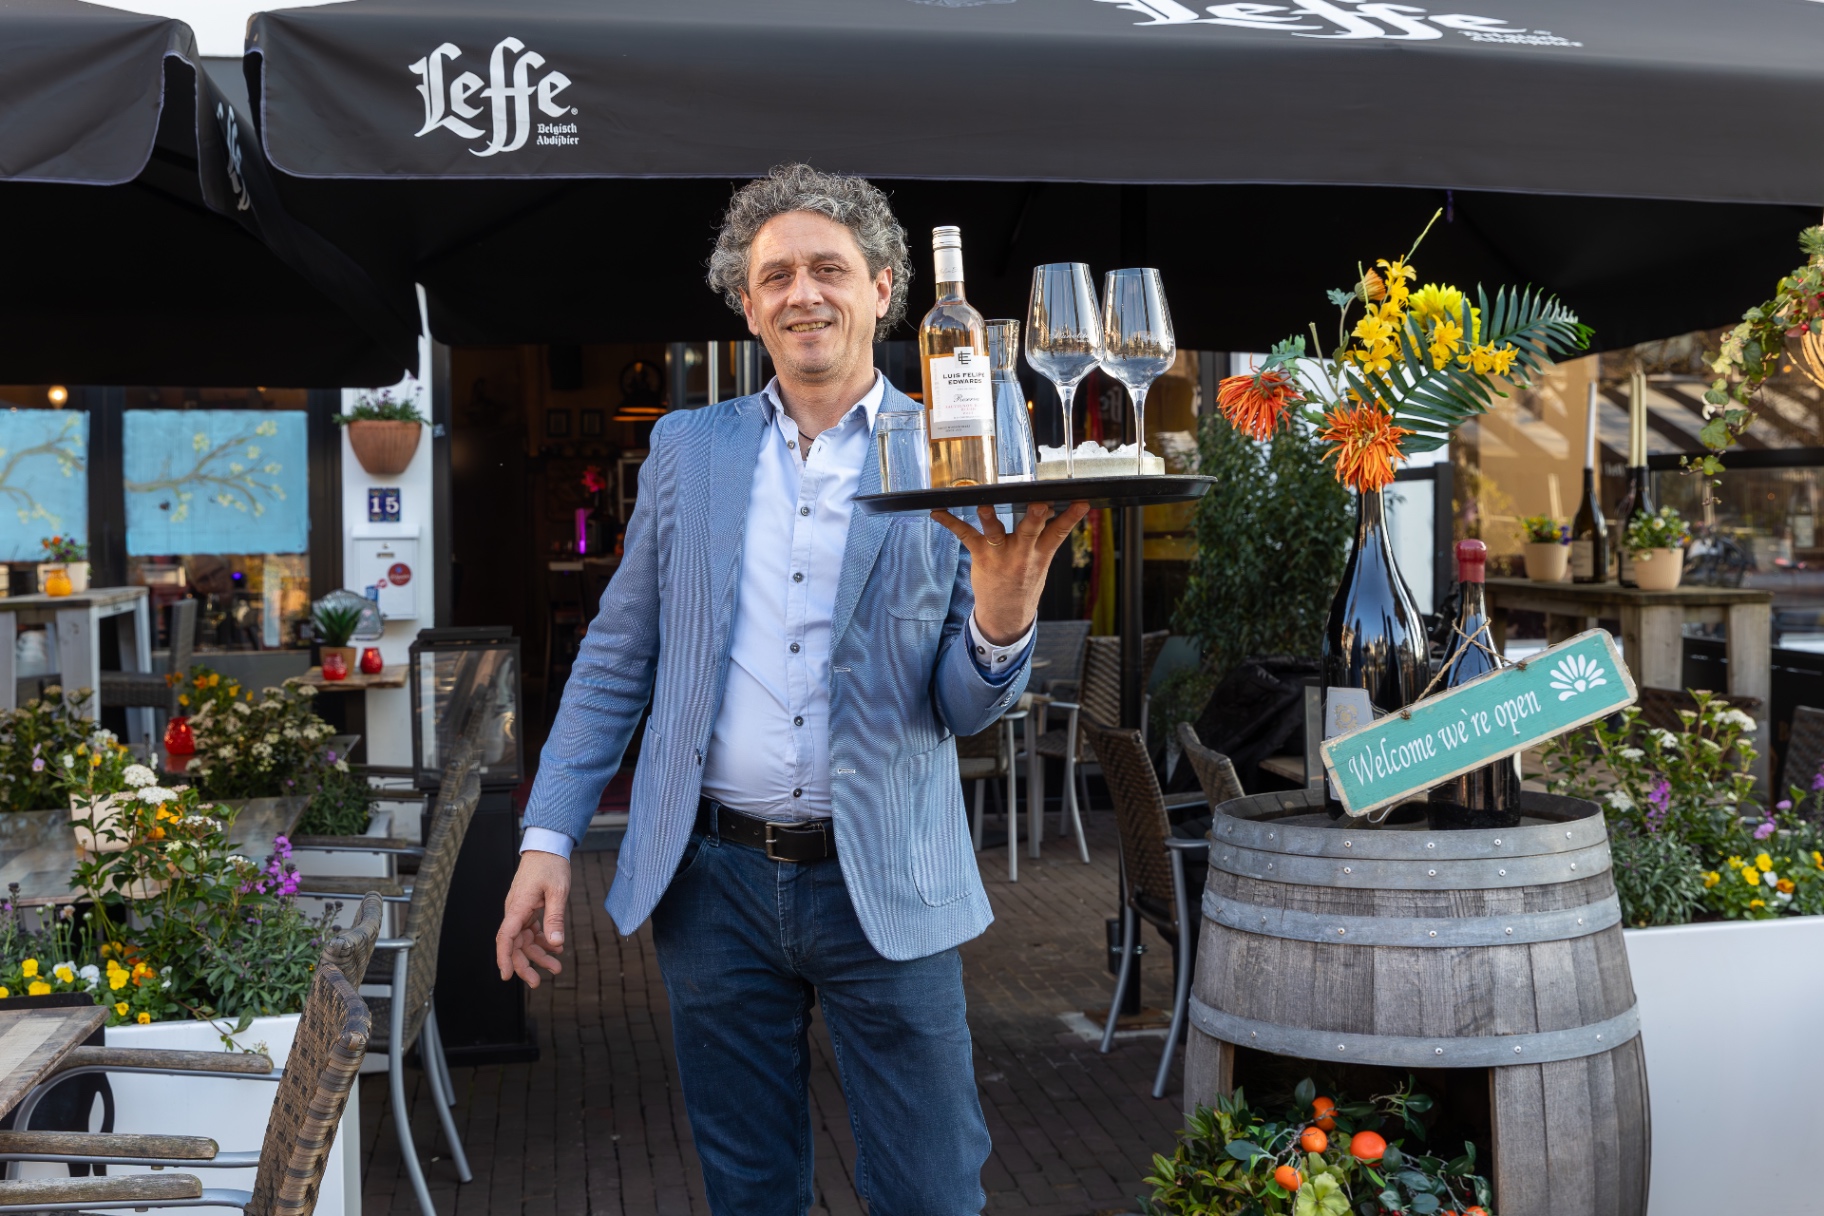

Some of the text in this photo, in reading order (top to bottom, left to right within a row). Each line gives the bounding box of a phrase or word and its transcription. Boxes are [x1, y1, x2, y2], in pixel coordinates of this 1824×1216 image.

[1096, 0, 1527, 40] Leffe
[408, 36, 572, 157] Leffe
[536, 123, 578, 135] Belgisch
[536, 135, 580, 147] Abdijbier
[370, 496, 400, 514] 15
[1348, 733, 1437, 787] Welcome
[1494, 690, 1542, 736] open
